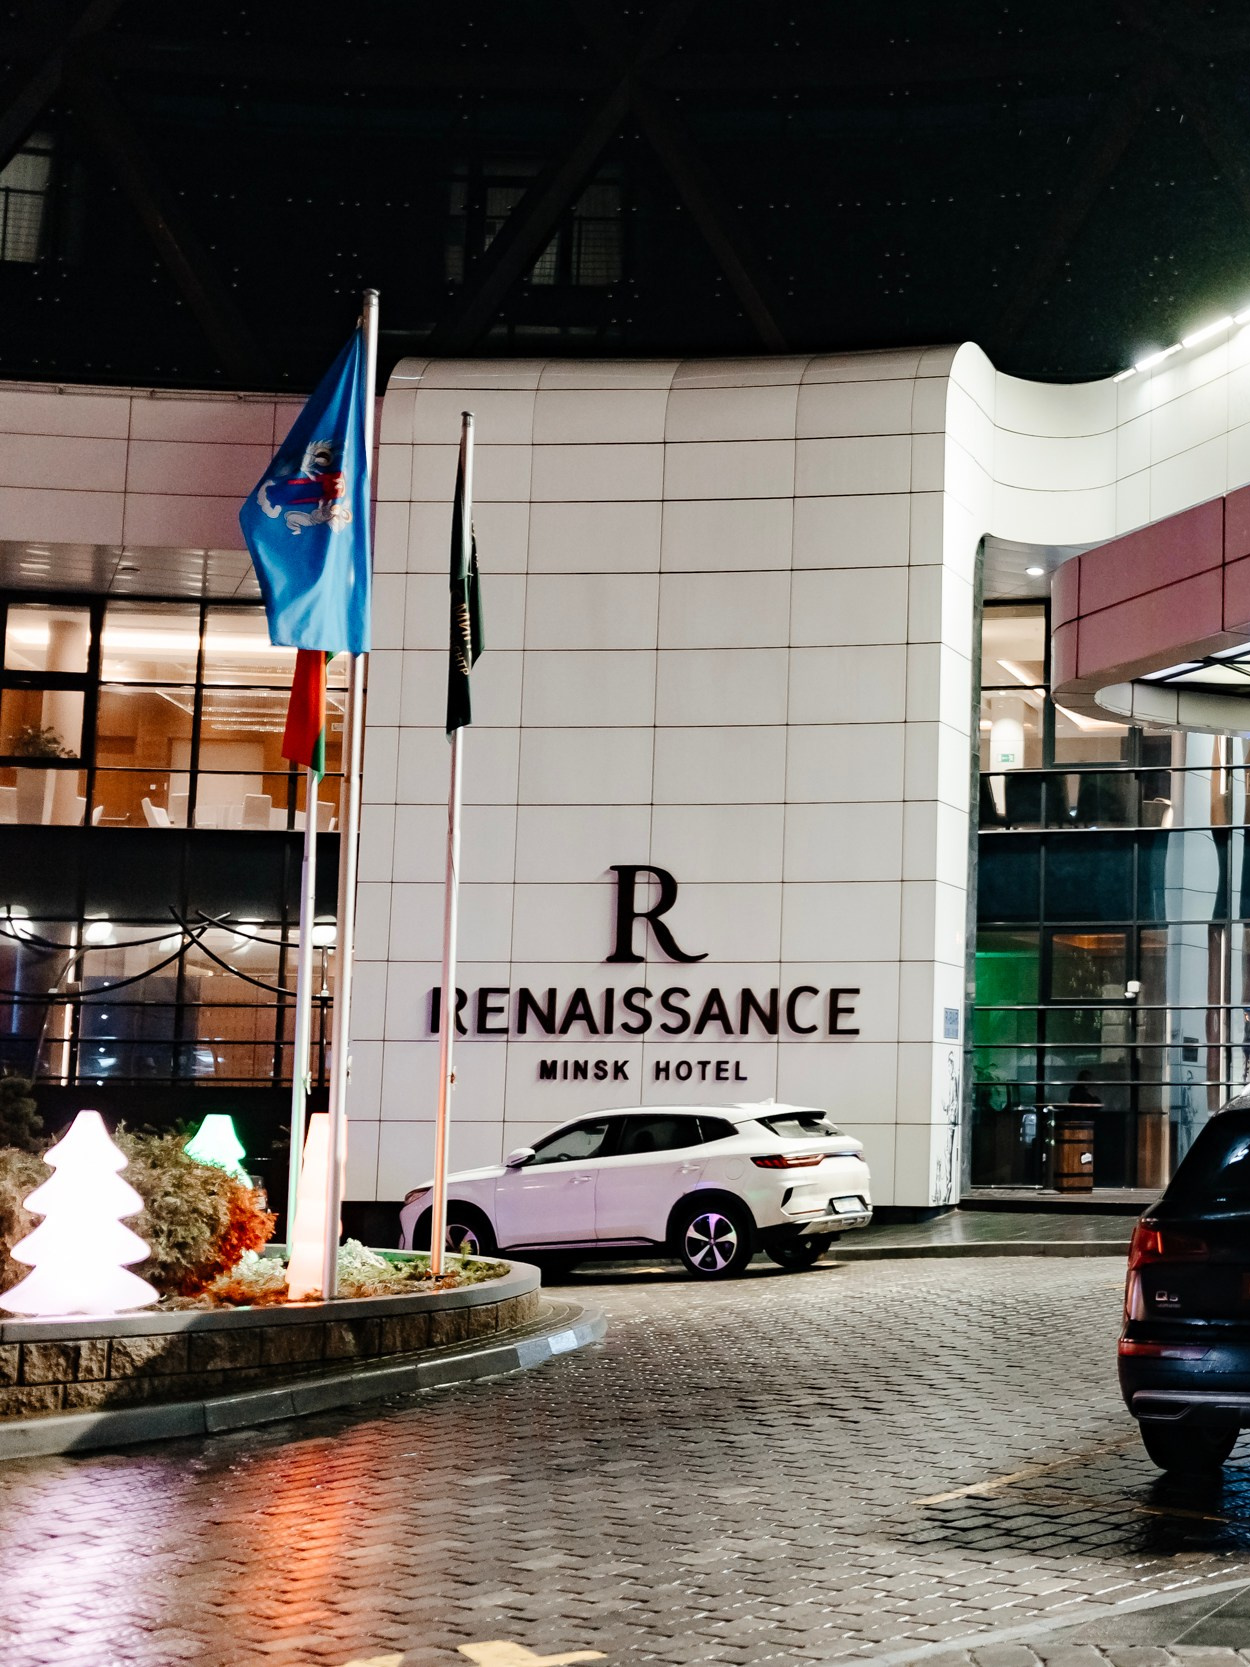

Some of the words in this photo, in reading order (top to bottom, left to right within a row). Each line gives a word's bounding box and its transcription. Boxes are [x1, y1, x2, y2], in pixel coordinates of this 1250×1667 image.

[606, 864, 710, 964] R
[430, 985, 861, 1036] RENAISSANCE
[539, 1059, 630, 1081] MINSK
[654, 1059, 749, 1081] HOTEL
